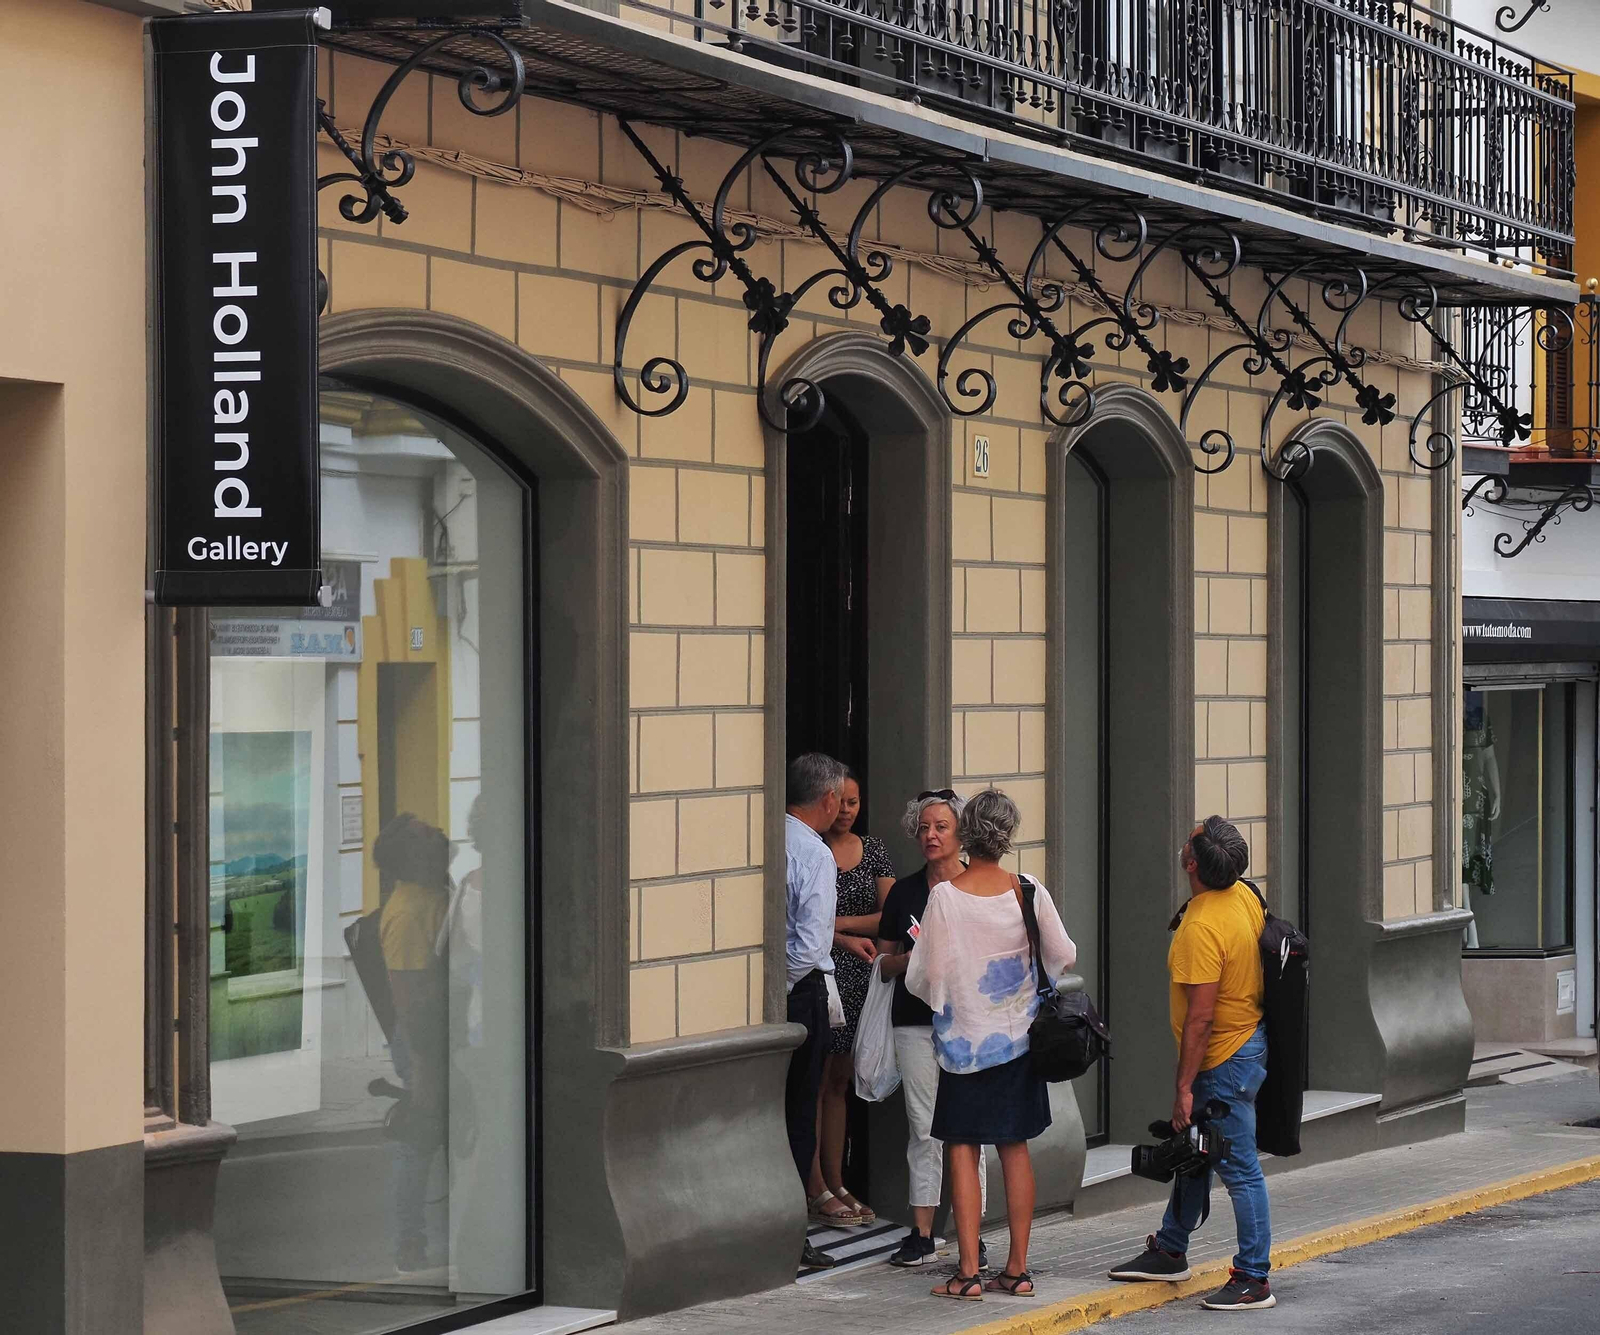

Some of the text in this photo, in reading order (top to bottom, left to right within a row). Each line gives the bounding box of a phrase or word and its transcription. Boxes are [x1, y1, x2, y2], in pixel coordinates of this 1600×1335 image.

[210, 51, 262, 518] John Holland
[976, 439, 989, 473] 26
[187, 535, 289, 566] Gallery
